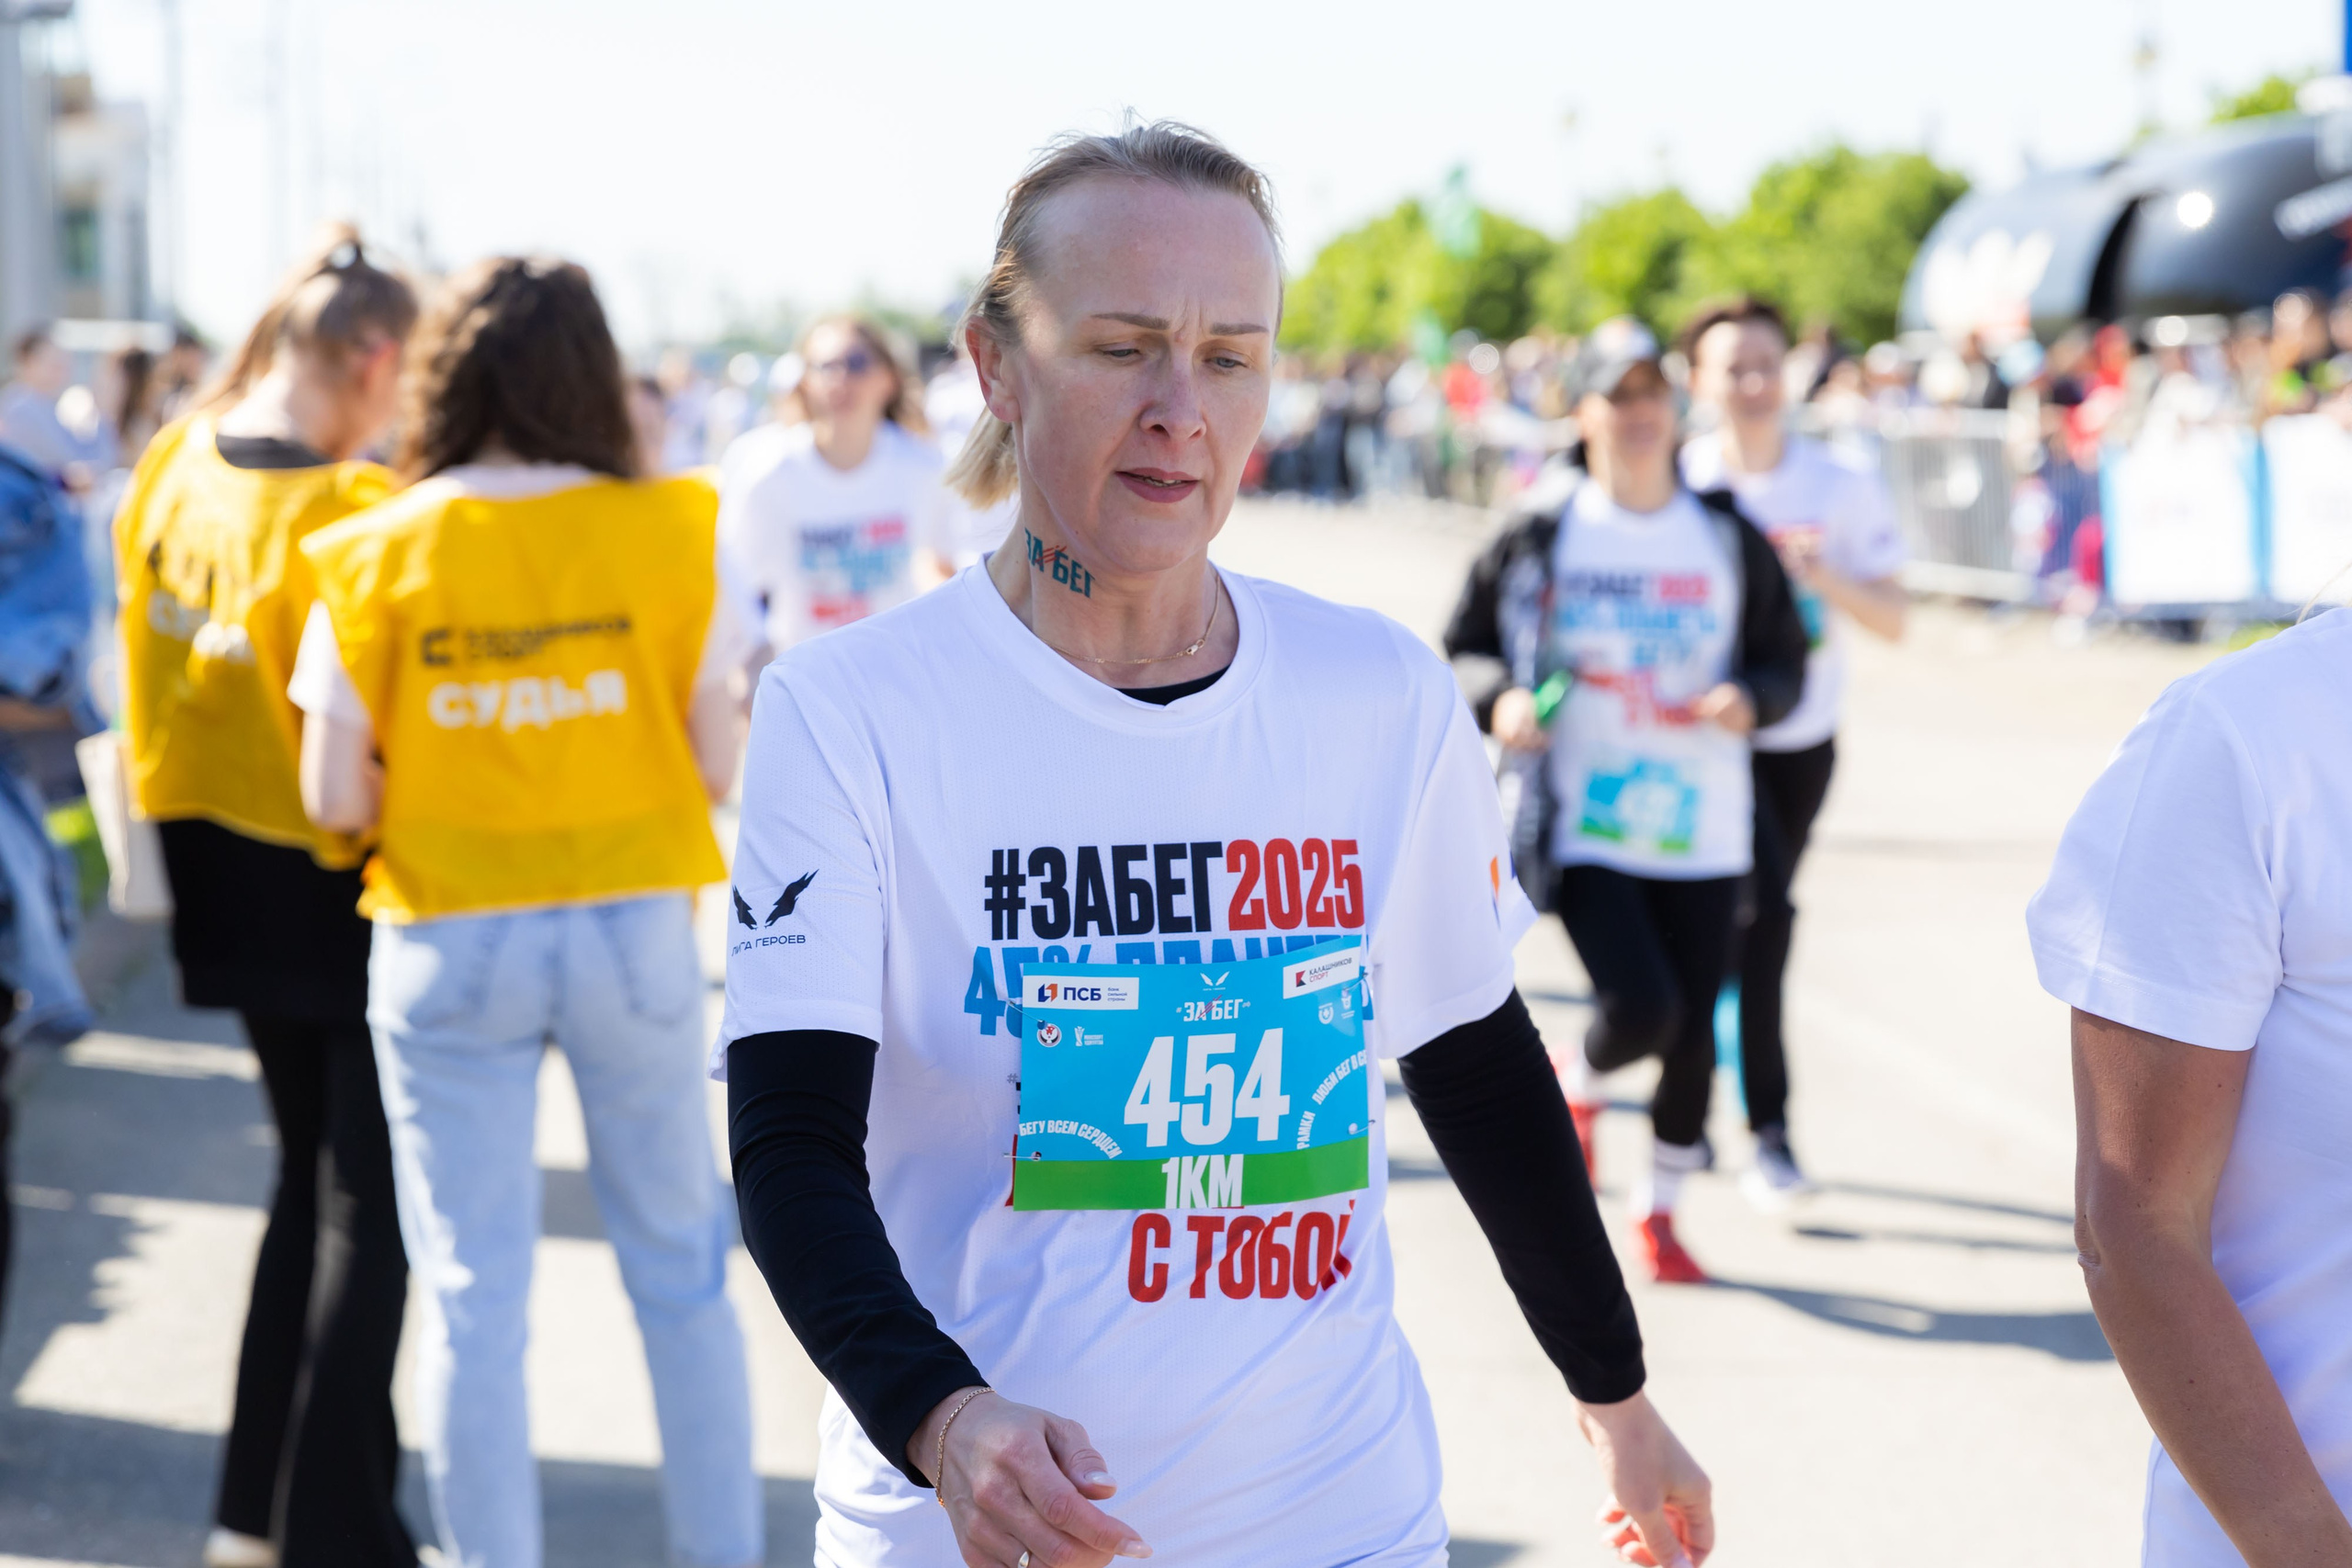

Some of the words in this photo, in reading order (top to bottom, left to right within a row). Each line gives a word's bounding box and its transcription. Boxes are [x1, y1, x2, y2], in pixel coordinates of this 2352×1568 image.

[984, 839, 1365, 941] #ЗАБЕГ2025
[755, 934, 807, 948] ГЕРОЕВ
[1309, 957, 1352, 975] КАЛАШНИКОВ
[1309, 972, 1329, 983] СПОРТ
[1063, 987, 1102, 1001] ПСБ
[1335, 1058, 1351, 1080] БЕГ
[1124, 1027, 1290, 1147] 454
[1019, 1120, 1046, 1136] БЕГУ
[1046, 1120, 1079, 1135] ВСЕМ
[1077, 1122, 1123, 1159] СЕРДЦЕМ
[1296, 1110, 1316, 1150] РАМКИ
[1127, 1213, 1171, 1303] С
